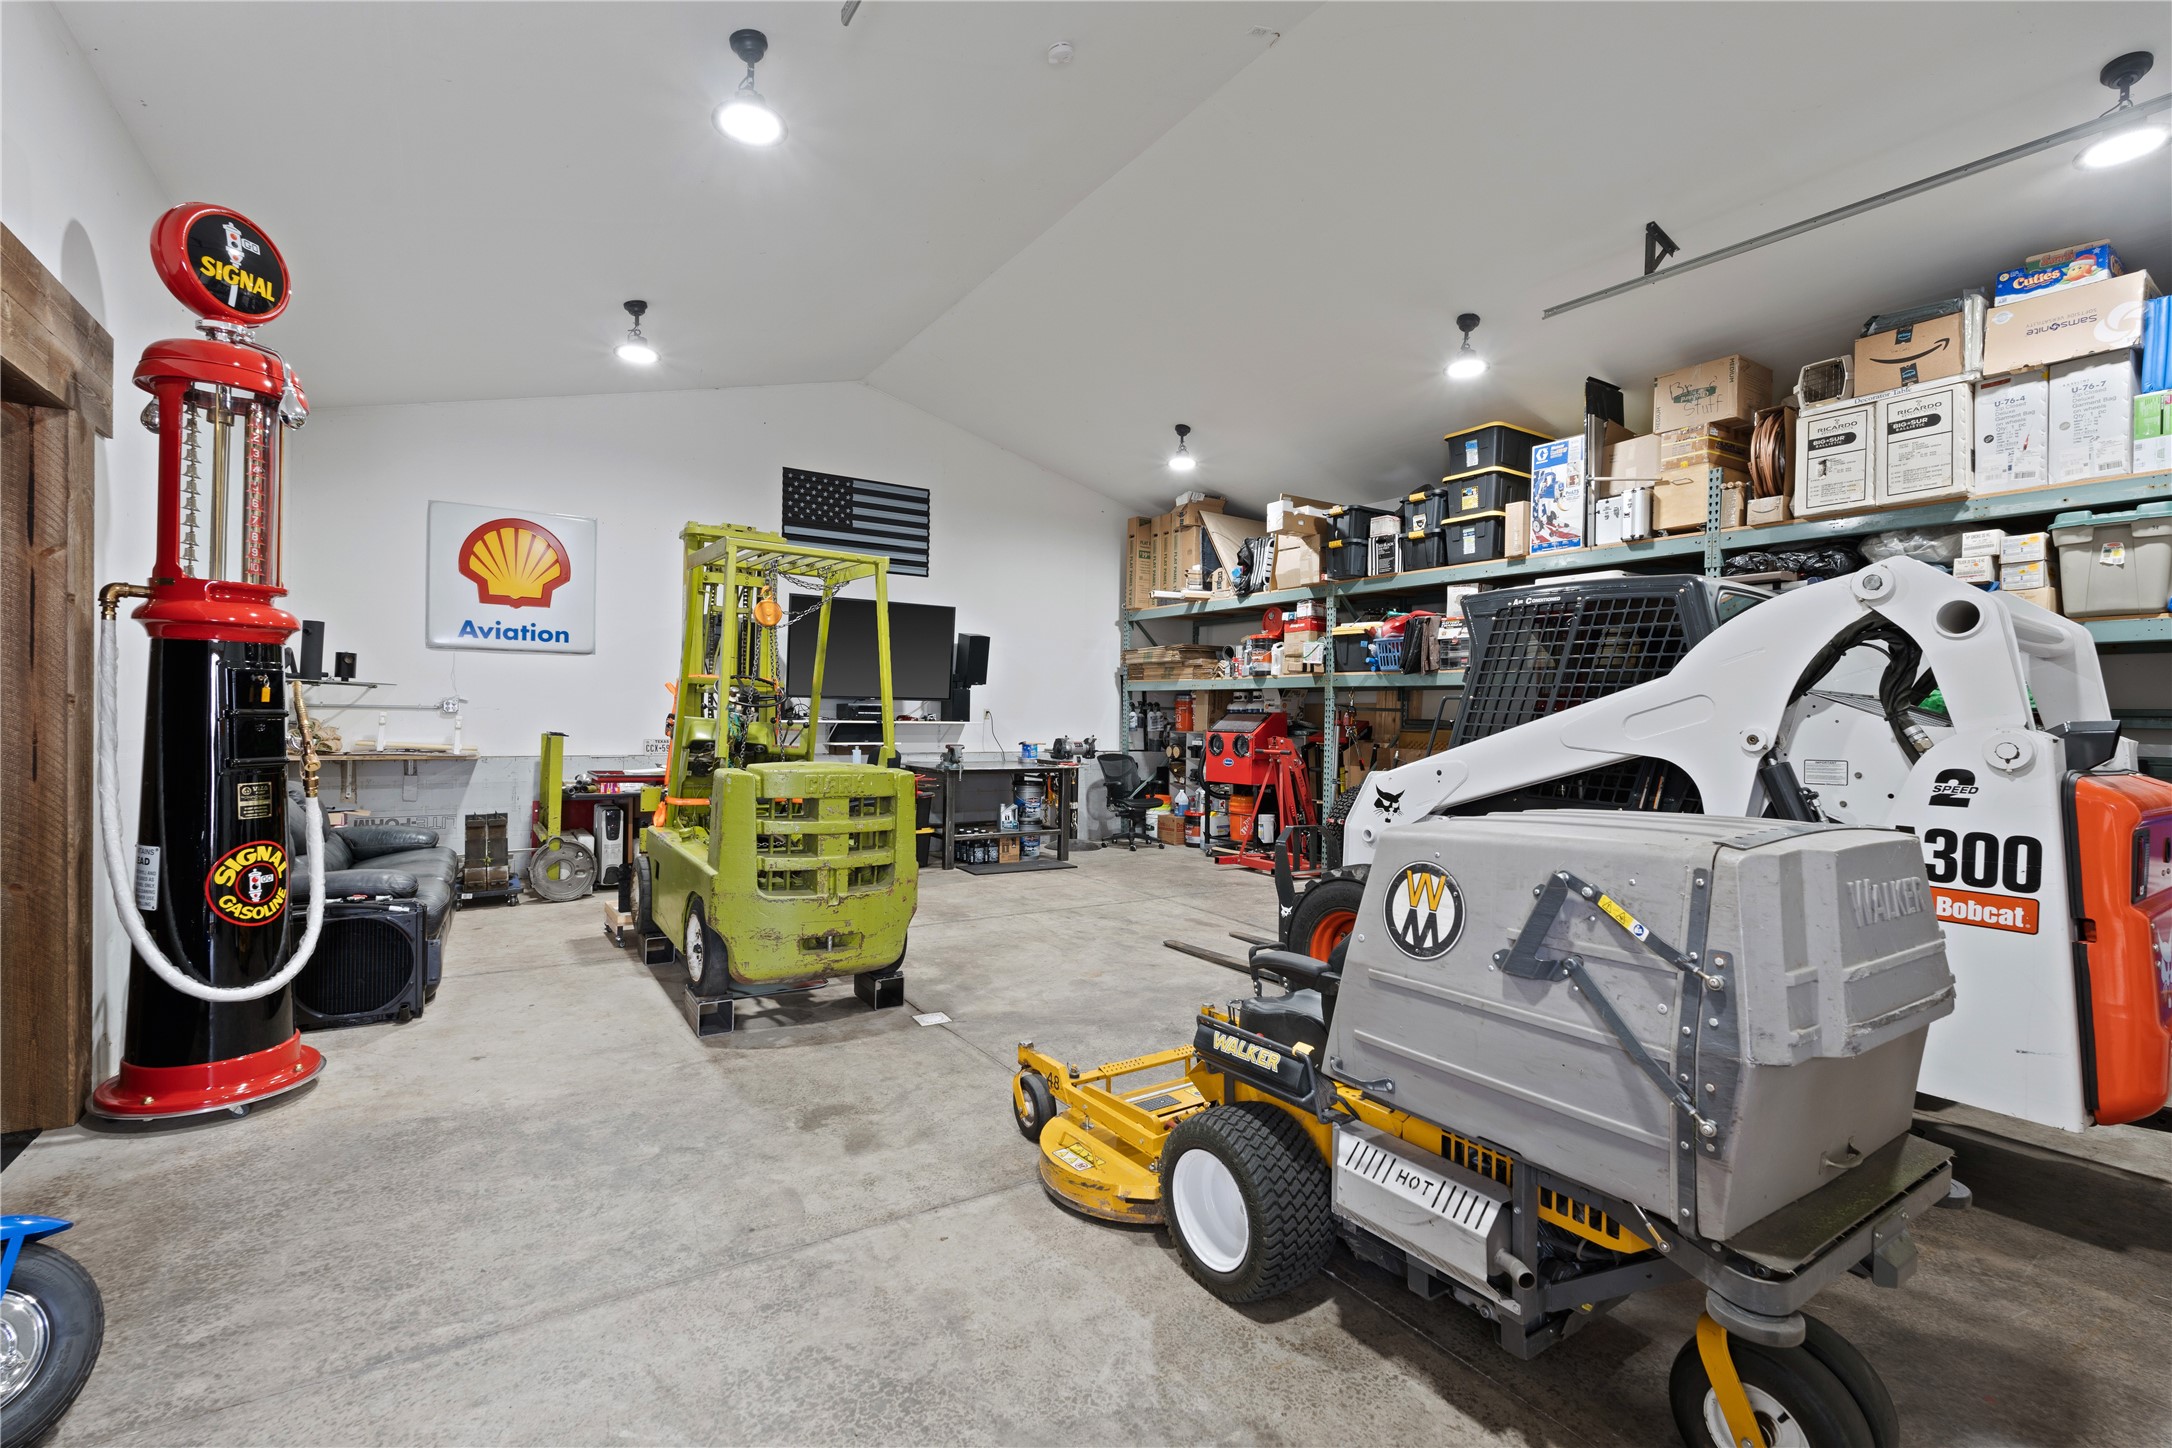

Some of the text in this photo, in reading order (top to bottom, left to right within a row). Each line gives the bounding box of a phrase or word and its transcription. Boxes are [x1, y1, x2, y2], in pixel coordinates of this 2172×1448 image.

[243, 240, 259, 254] GO
[200, 256, 275, 302] SIGNAL
[2012, 269, 2061, 289] Cuties
[2026, 314, 2098, 336] Samsonite
[1854, 387, 1913, 405] Decorator Table
[2071, 380, 2107, 394] U-76-7
[2084, 387, 2107, 397] Closed
[1994, 395, 2026, 407] U-76-4
[2005, 401, 2027, 410] Closed
[2072, 395, 2095, 403] Deluxe
[2072, 395, 2117, 409] Garment Bag
[2083, 403, 2107, 413] wheels
[1897, 401, 1943, 416] RICARDO
[1995, 409, 2016, 417] Deluxe
[1995, 409, 2036, 422] Garment Bag
[1817, 421, 1858, 434] RICARDO
[2005, 417, 2026, 426] wheels
[458, 620, 569, 643] Aviation
[805, 775, 864, 793] CLARK
[1928, 768, 1976, 808] 2
[1932, 784, 1979, 795] SPEED
[214, 845, 287, 888] SIGNAL
[1896, 825, 2043, 893] 300
[219, 887, 287, 919] GASOLINE
[1846, 876, 1927, 929] WALKER
[1936, 895, 2026, 928] Bobcat
[1213, 1031, 1281, 1073] WALKER
[1047, 1072, 1060, 1090] 48
[1396, 1169, 1434, 1196] HOT
